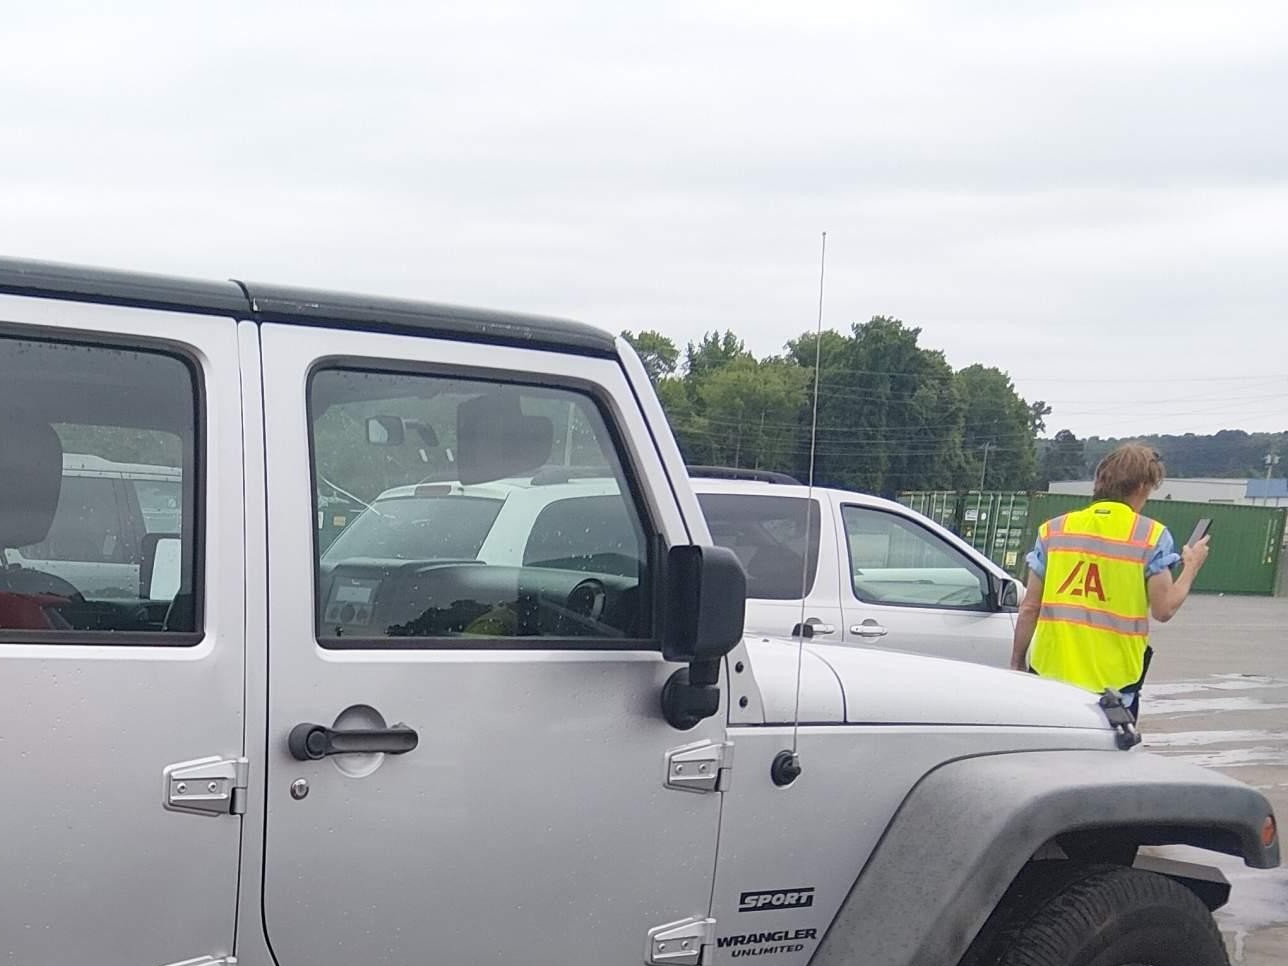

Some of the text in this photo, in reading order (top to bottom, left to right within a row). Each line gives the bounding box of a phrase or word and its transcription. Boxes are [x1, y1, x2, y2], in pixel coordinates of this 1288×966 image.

[741, 891, 814, 909] SPORT
[717, 928, 817, 948] WRANGLER
[731, 944, 804, 958] UNLIMITED
